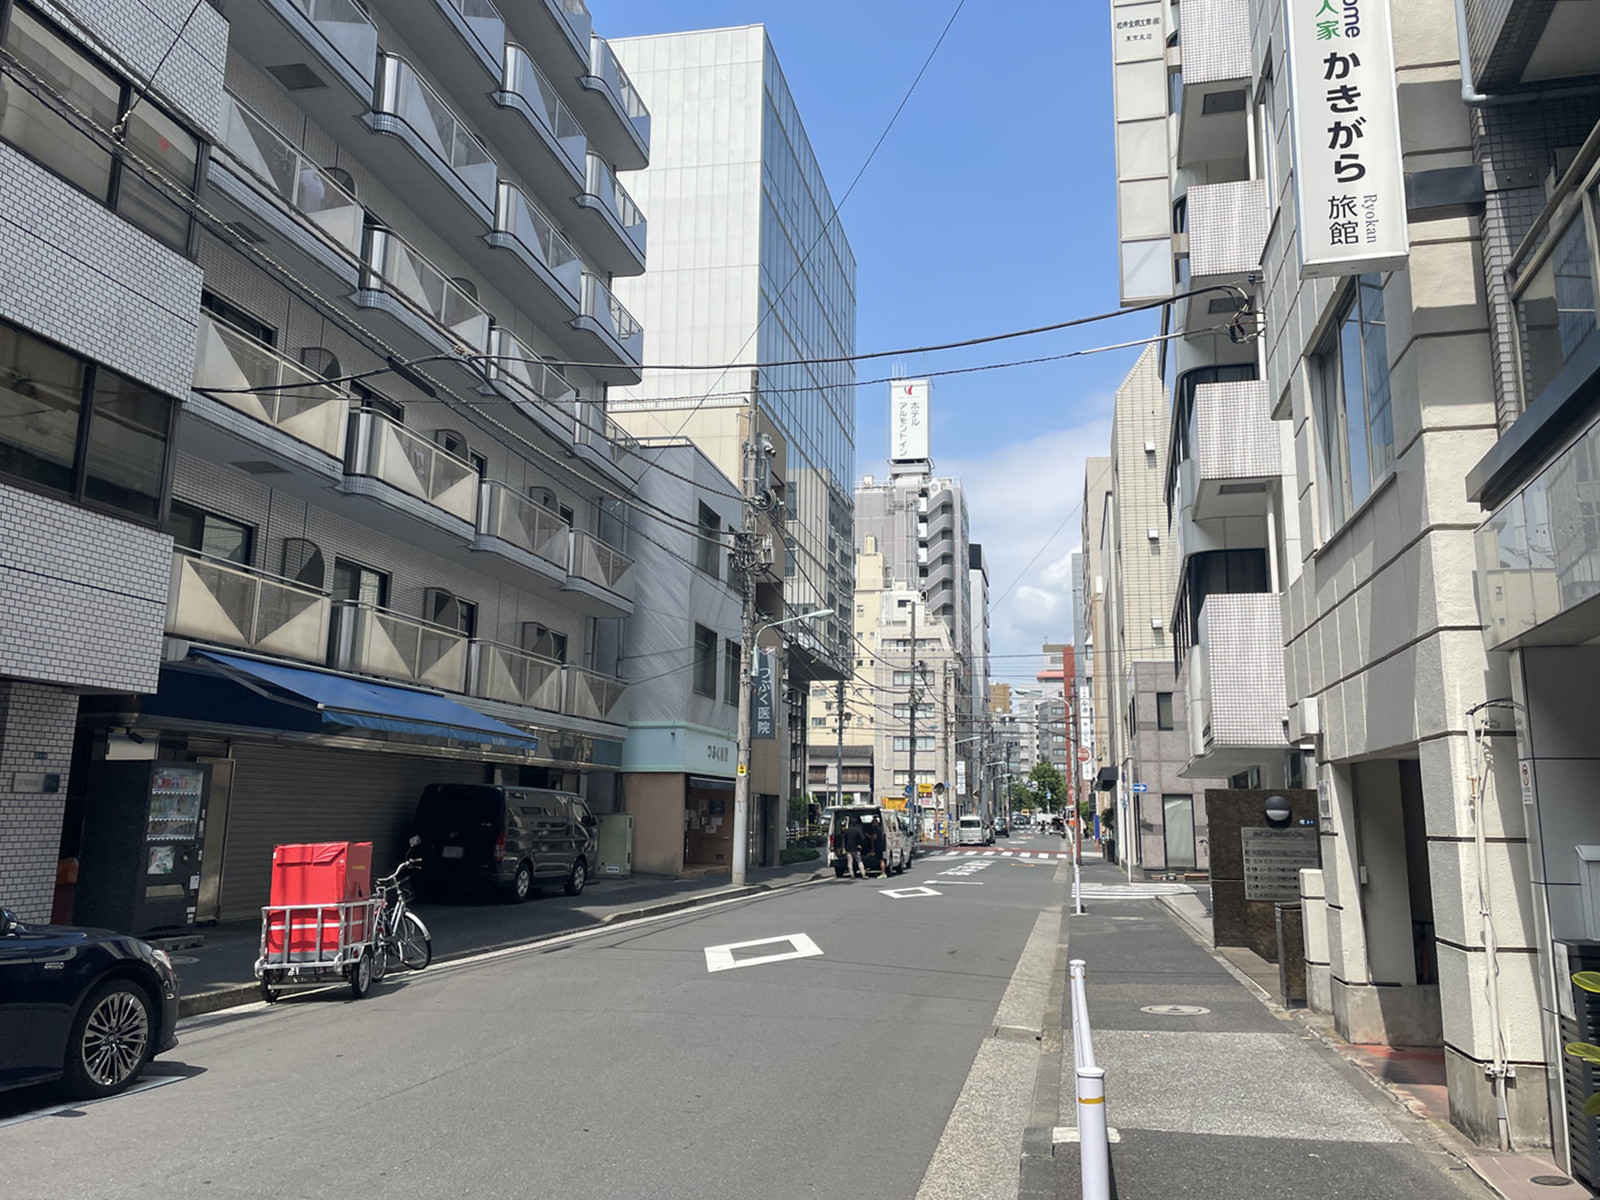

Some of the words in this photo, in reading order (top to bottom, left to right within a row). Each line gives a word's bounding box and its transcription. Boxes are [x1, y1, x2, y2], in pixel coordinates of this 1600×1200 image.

[1323, 52, 1367, 184] かきがら
[1327, 194, 1359, 246] 旅館
[1362, 194, 1378, 244] Ryokan
[910, 402, 920, 427] ホテル
[757, 667, 771, 734] つぶく医院
